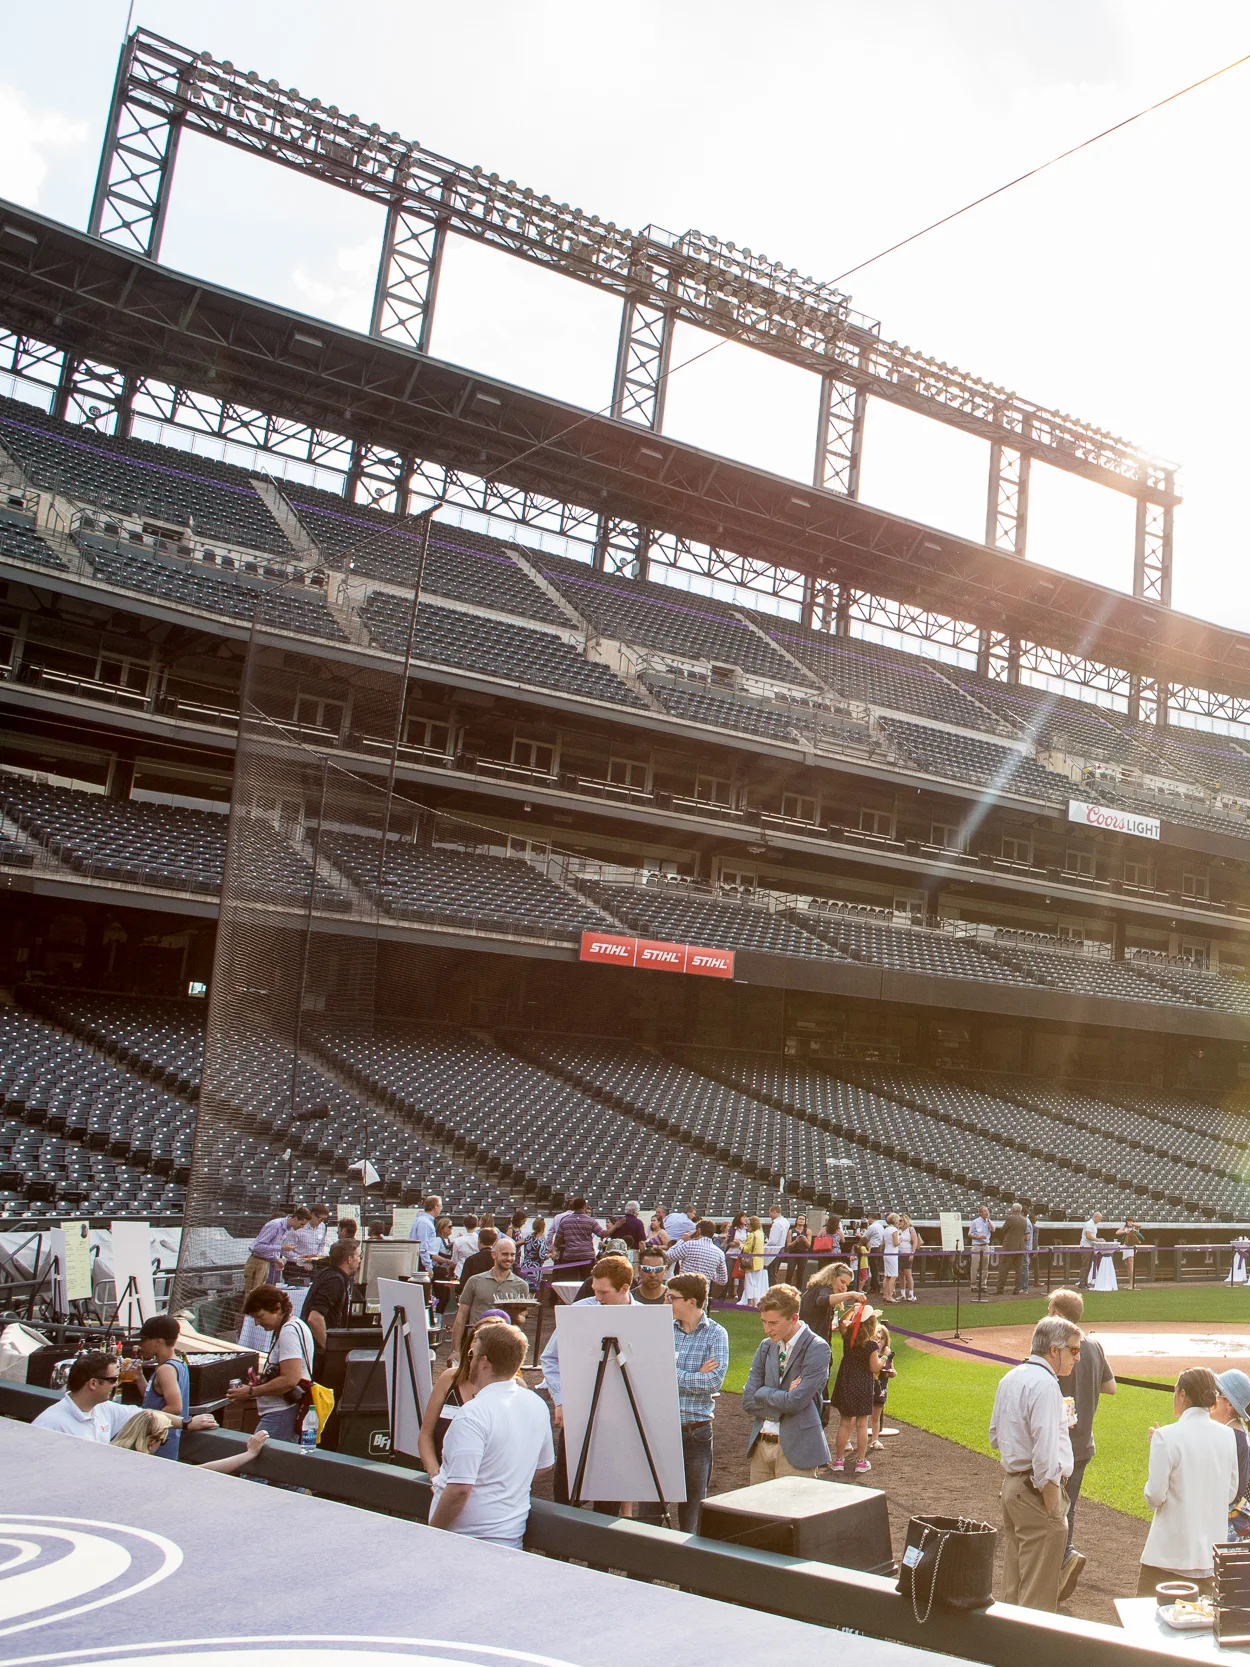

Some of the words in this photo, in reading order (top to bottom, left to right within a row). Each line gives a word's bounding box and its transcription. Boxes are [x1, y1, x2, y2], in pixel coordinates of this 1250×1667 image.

[1087, 805, 1125, 830] Coors
[1127, 820, 1160, 837] LIGHT
[589, 942, 629, 956] STIHL
[641, 949, 680, 963] STIHL
[691, 956, 728, 969] STIHL
